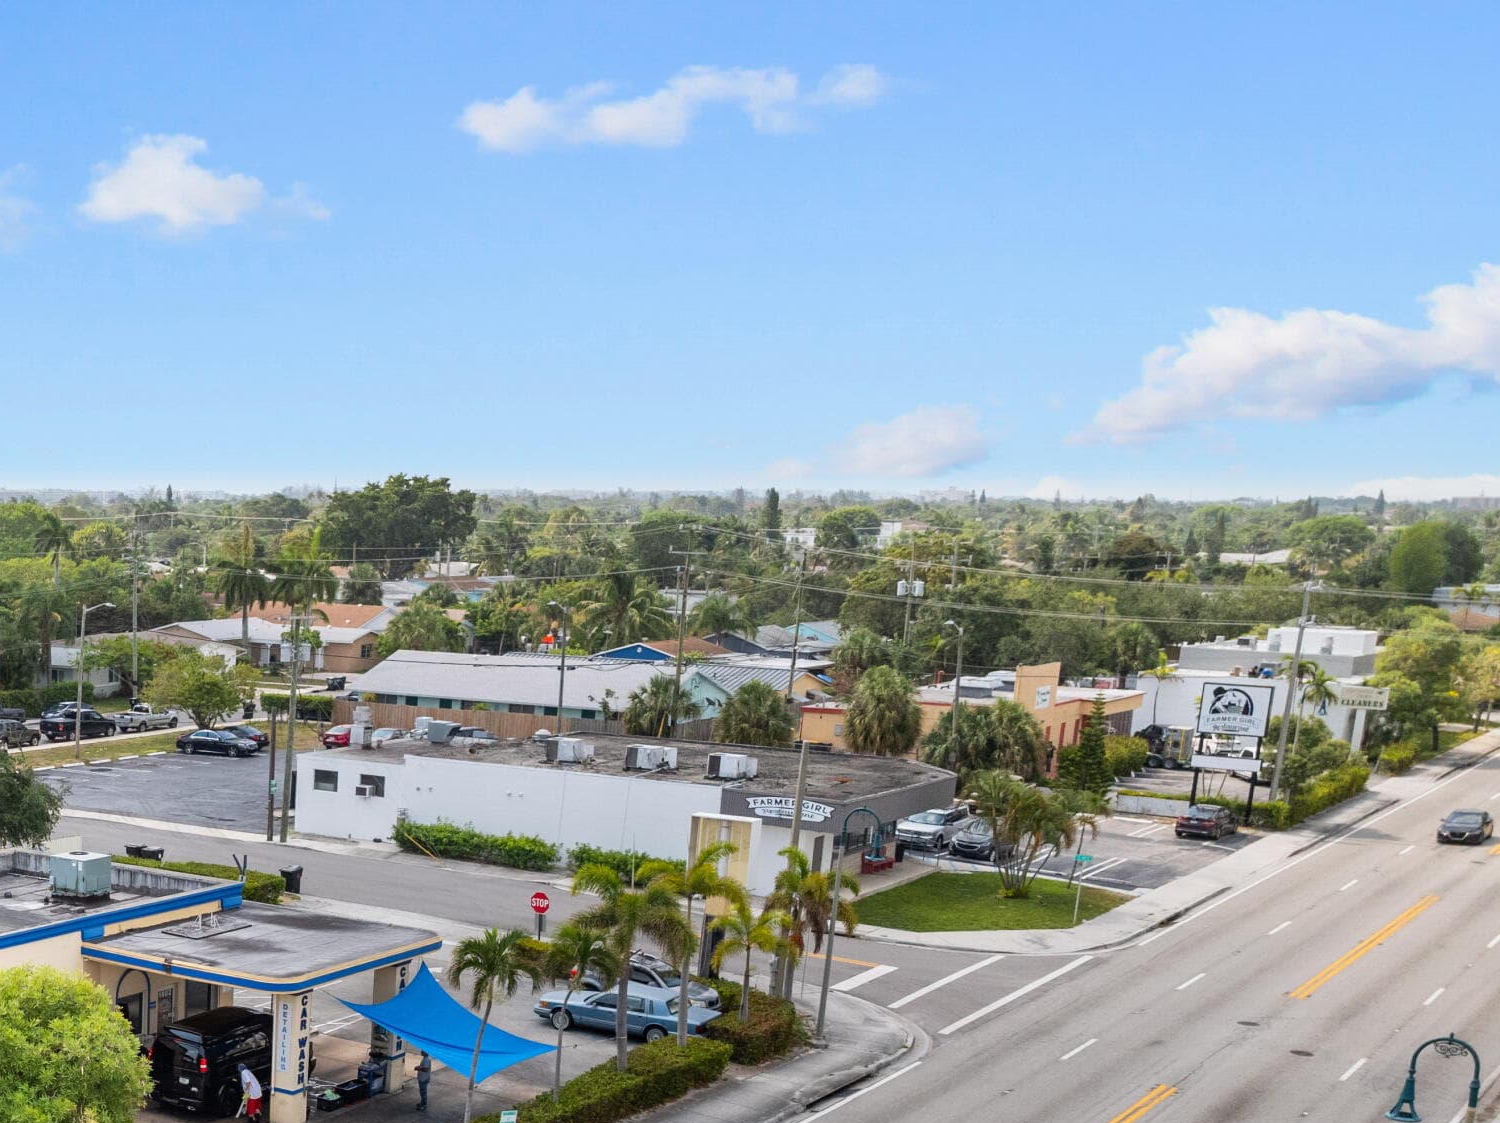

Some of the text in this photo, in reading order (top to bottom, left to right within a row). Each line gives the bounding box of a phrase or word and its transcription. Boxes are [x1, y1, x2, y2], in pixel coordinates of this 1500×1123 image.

[1239, 718, 1257, 726] GIRL
[802, 802, 828, 814] GIRL
[531, 897, 549, 908] STOP
[280, 1003, 289, 1071] DETAILING
[297, 995, 308, 1085] CAR WASH
